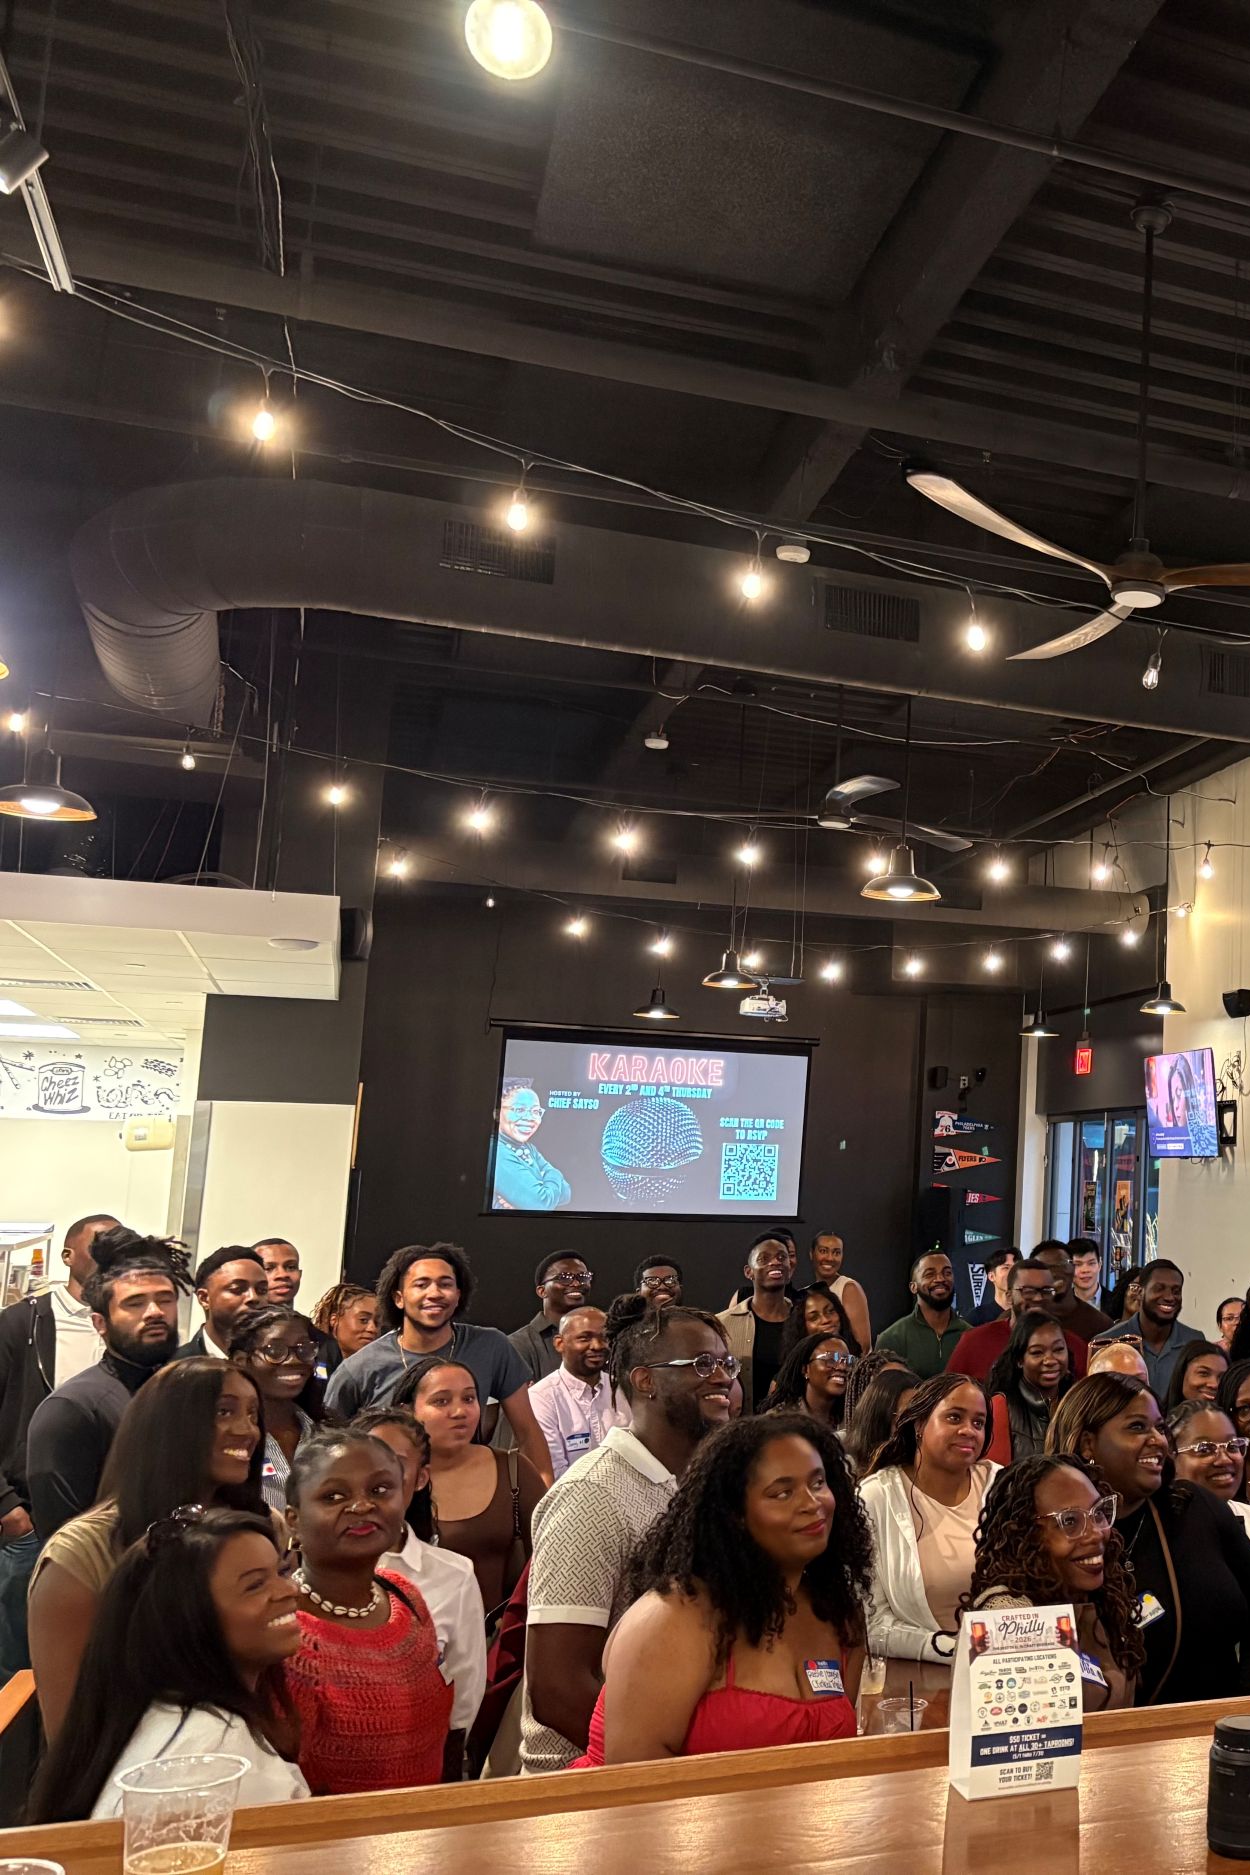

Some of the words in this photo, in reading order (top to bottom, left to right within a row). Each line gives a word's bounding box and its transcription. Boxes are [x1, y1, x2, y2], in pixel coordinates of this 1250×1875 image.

[588, 1053, 725, 1087] KARAOKE
[599, 1083, 623, 1095] EVERY
[640, 1085, 656, 1096] AND
[672, 1087, 713, 1099] THURSDAY
[548, 1098, 571, 1109] CHIEF
[573, 1098, 600, 1110] SAYSO
[720, 1117, 740, 1128] SCAN
[740, 1118, 753, 1128] THE
[755, 1118, 765, 1128] QR
[766, 1119, 785, 1129] CODE
[735, 1129, 746, 1140] TO
[747, 1130, 768, 1140] RSVP
[958, 1155, 977, 1163] FLYERS
[1002, 1613, 1031, 1621] CRAFTED
[998, 1619, 1045, 1641] Philly
[1002, 1655, 1033, 1663] PARTICIPATING
[1034, 1653, 1057, 1661] LOCATIONS
[1022, 1733, 1040, 1741] TICKET
[980, 1747, 991, 1756] ONE
[992, 1746, 1009, 1755] DRINK
[1010, 1744, 1017, 1752] AT
[1018, 1743, 1030, 1752] ALL
[1000, 1768, 1014, 1776] SCAN
[1022, 1765, 1033, 1773] BUY
[999, 1775, 1013, 1783] YOUR
[1014, 1773, 1032, 1782] TICKET!
